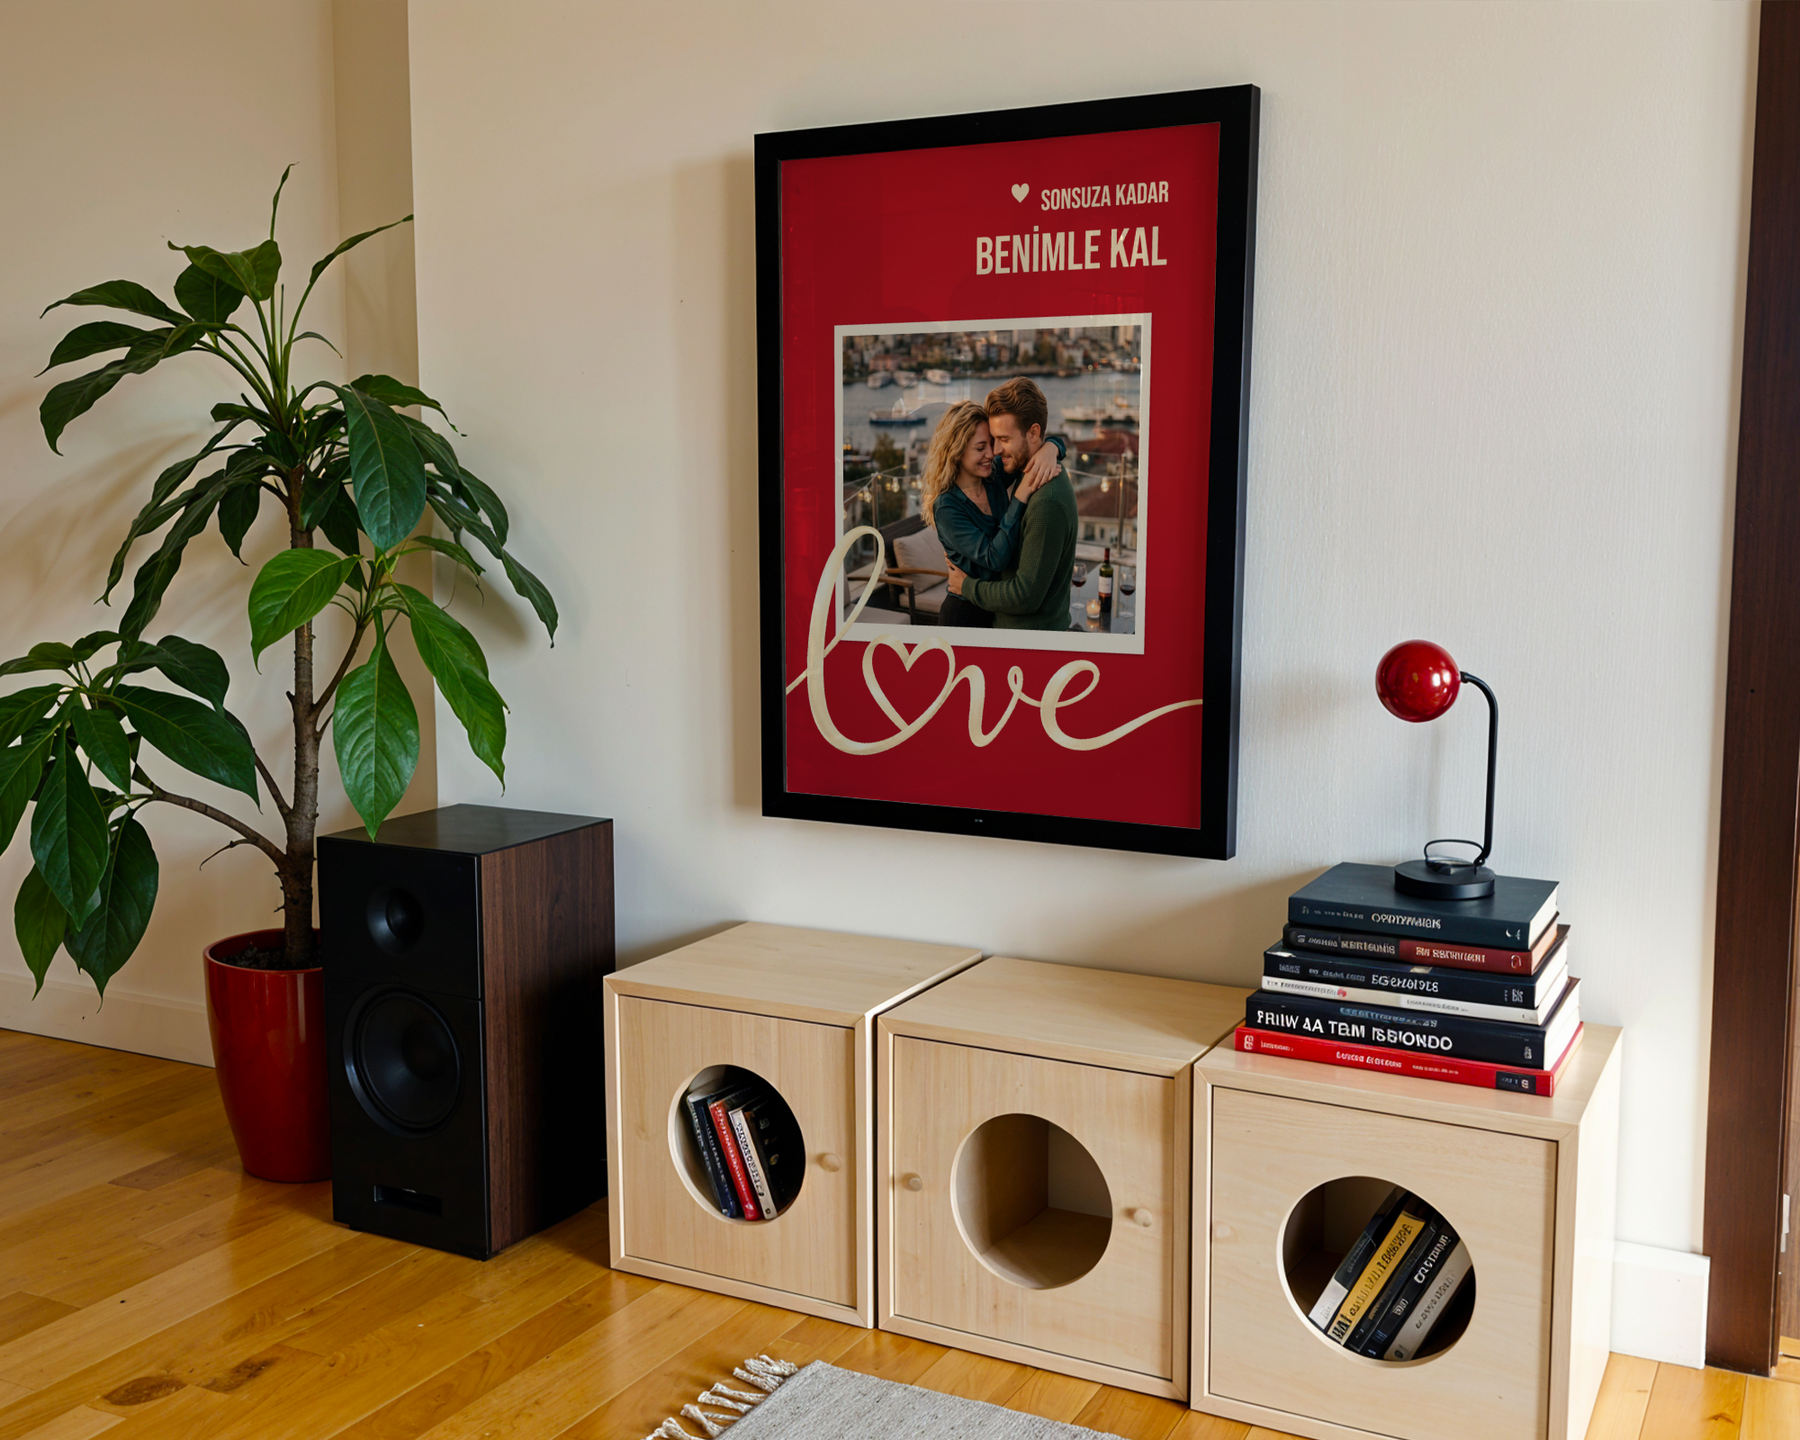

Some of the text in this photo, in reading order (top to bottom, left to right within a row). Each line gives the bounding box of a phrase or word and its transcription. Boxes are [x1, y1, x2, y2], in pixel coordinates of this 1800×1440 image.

[1040, 180, 1169, 212] SONSUZA KADAR
[976, 225, 1168, 275] BENİMLE KAL
